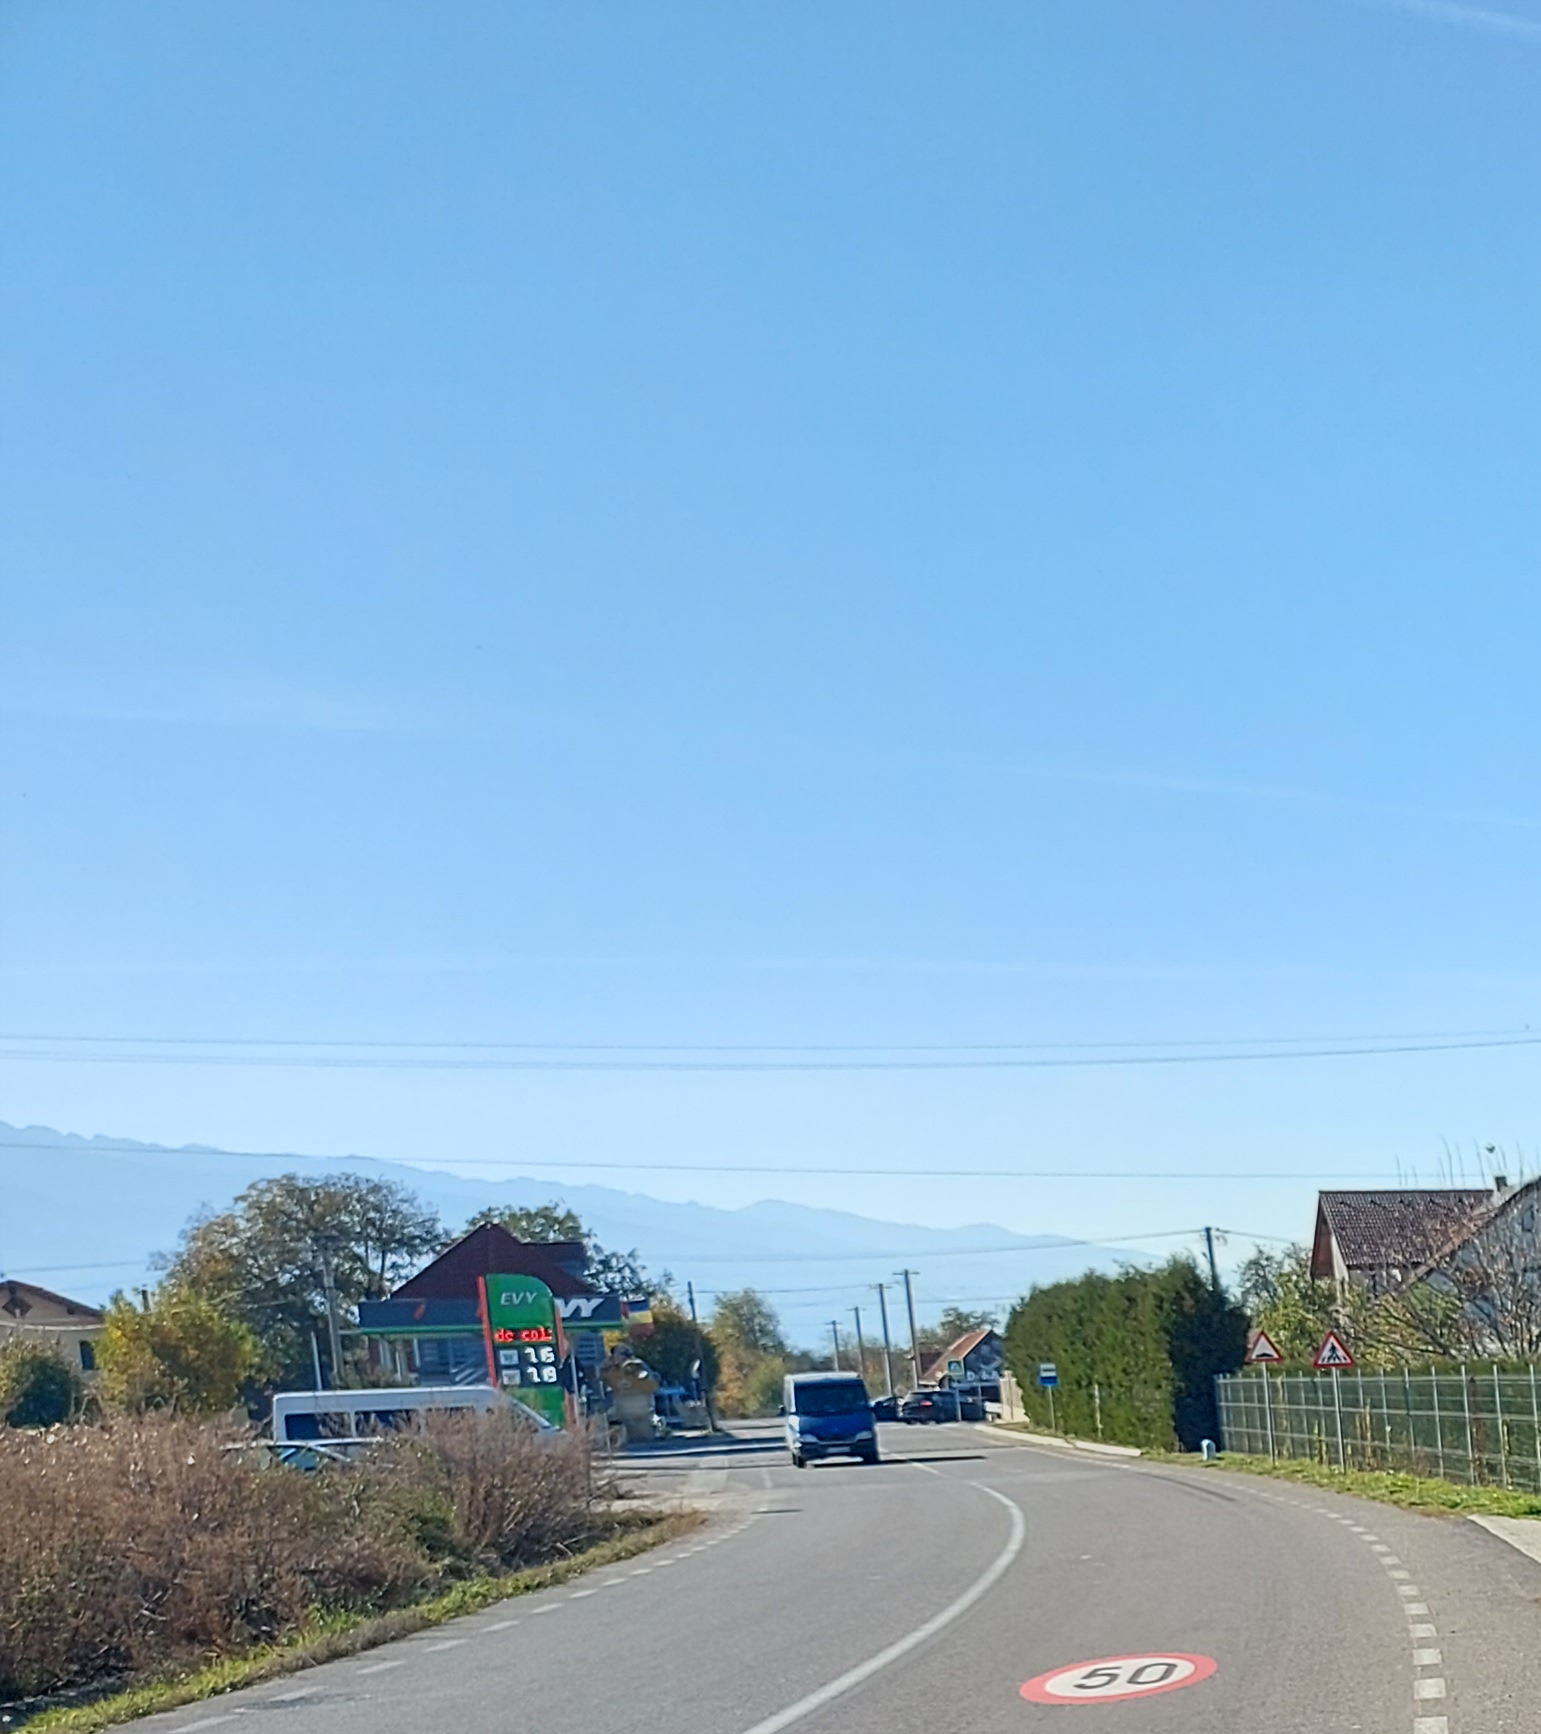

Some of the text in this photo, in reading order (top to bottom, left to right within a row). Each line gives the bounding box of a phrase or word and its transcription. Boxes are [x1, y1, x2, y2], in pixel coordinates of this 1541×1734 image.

[499, 1291, 538, 1306] EVY
[553, 1297, 606, 1318] VY
[1072, 1662, 1179, 1690] 50
